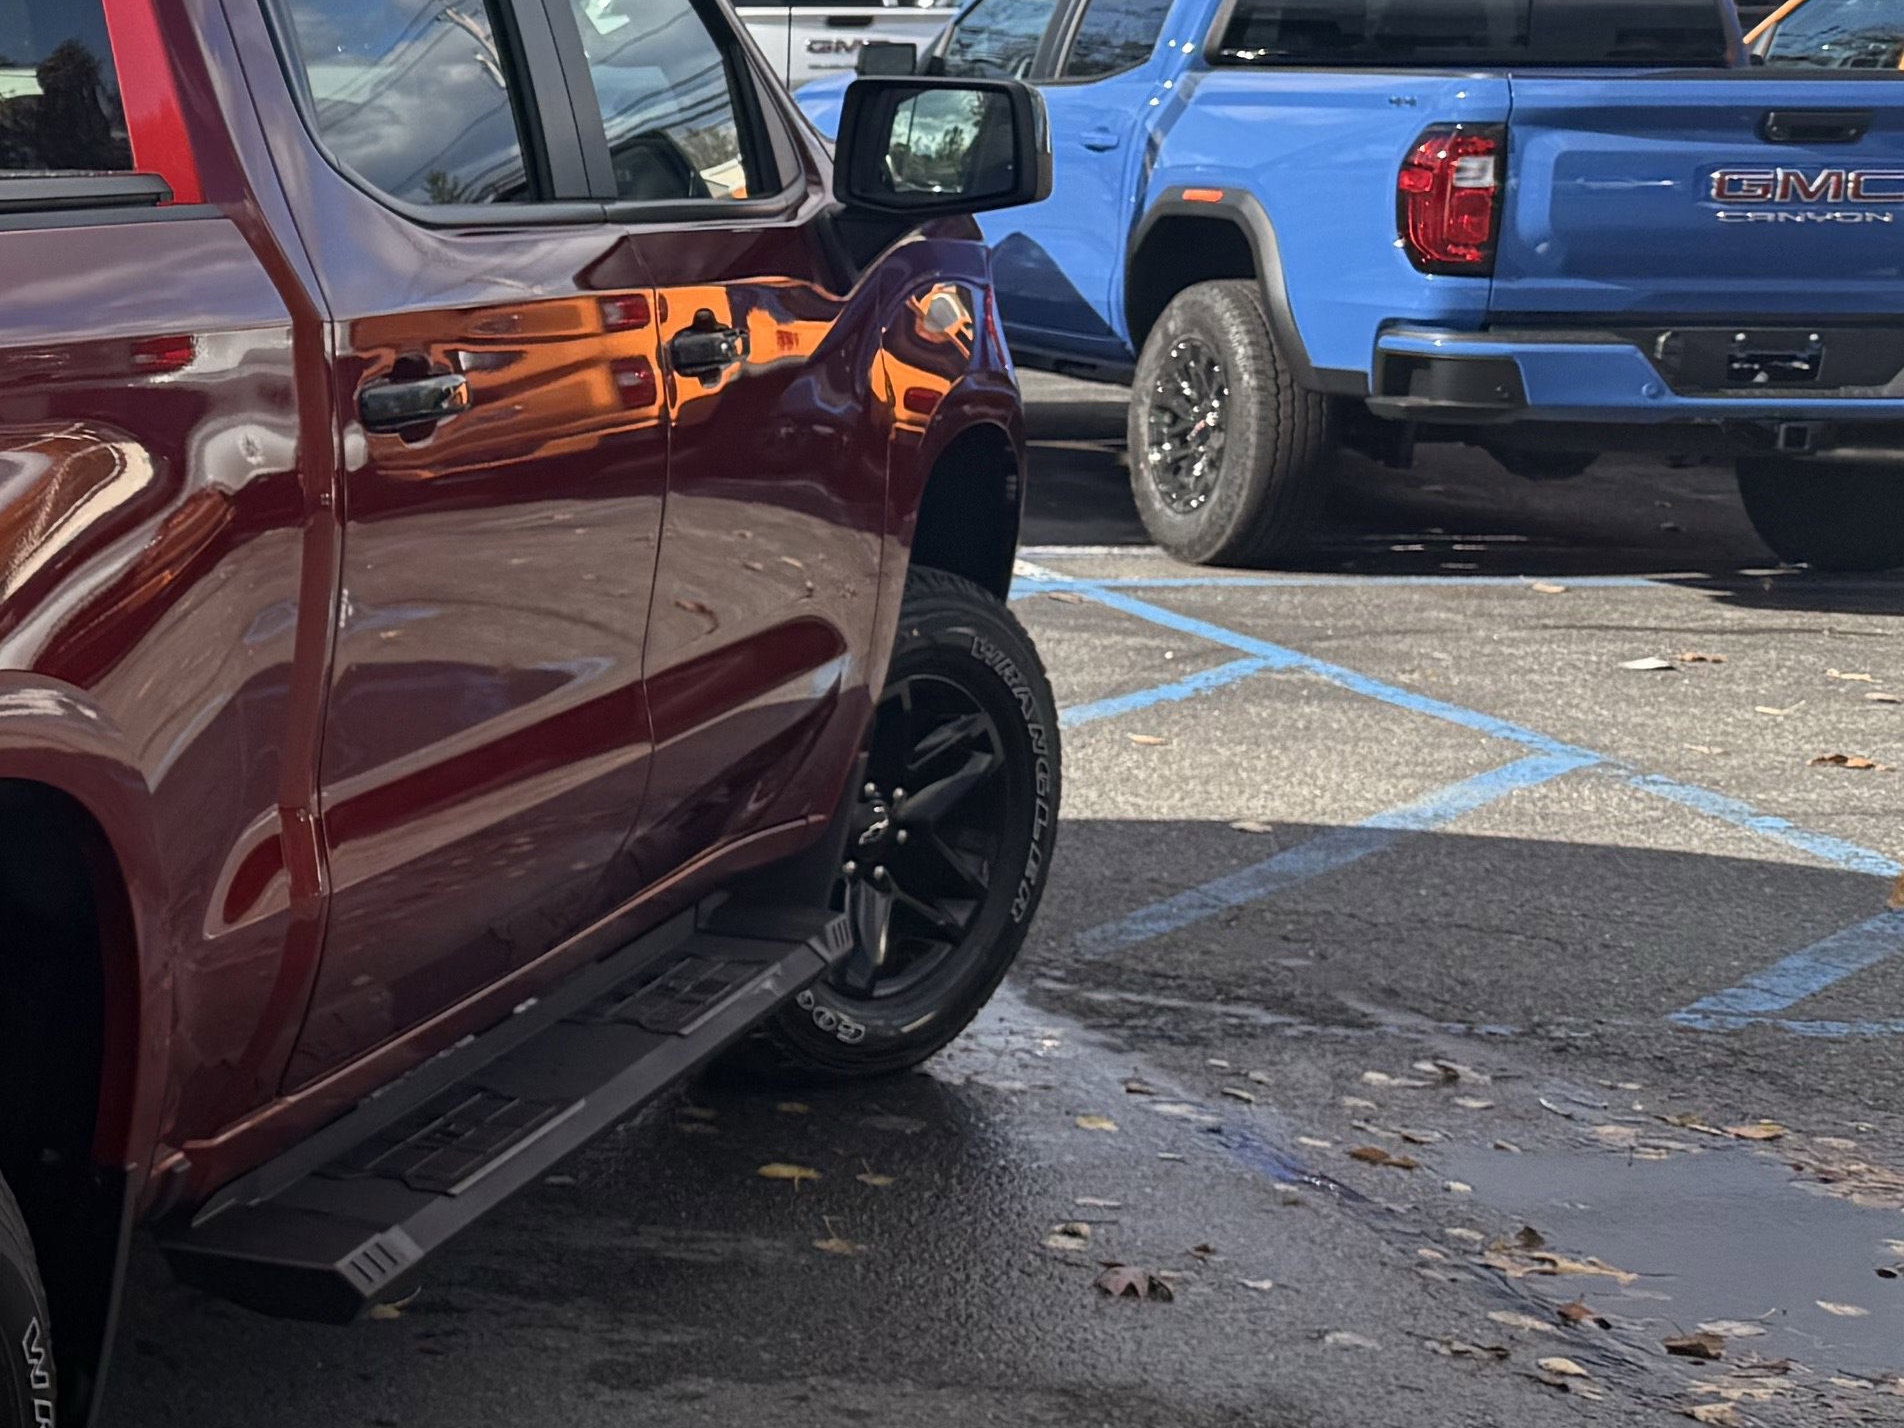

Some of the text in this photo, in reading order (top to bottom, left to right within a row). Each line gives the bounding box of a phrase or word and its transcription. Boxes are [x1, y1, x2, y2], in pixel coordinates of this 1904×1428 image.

[1710, 167, 1904, 202] GMC
[1716, 211, 1893, 222] CANYON
[971, 635, 1053, 924] WRANGLER
